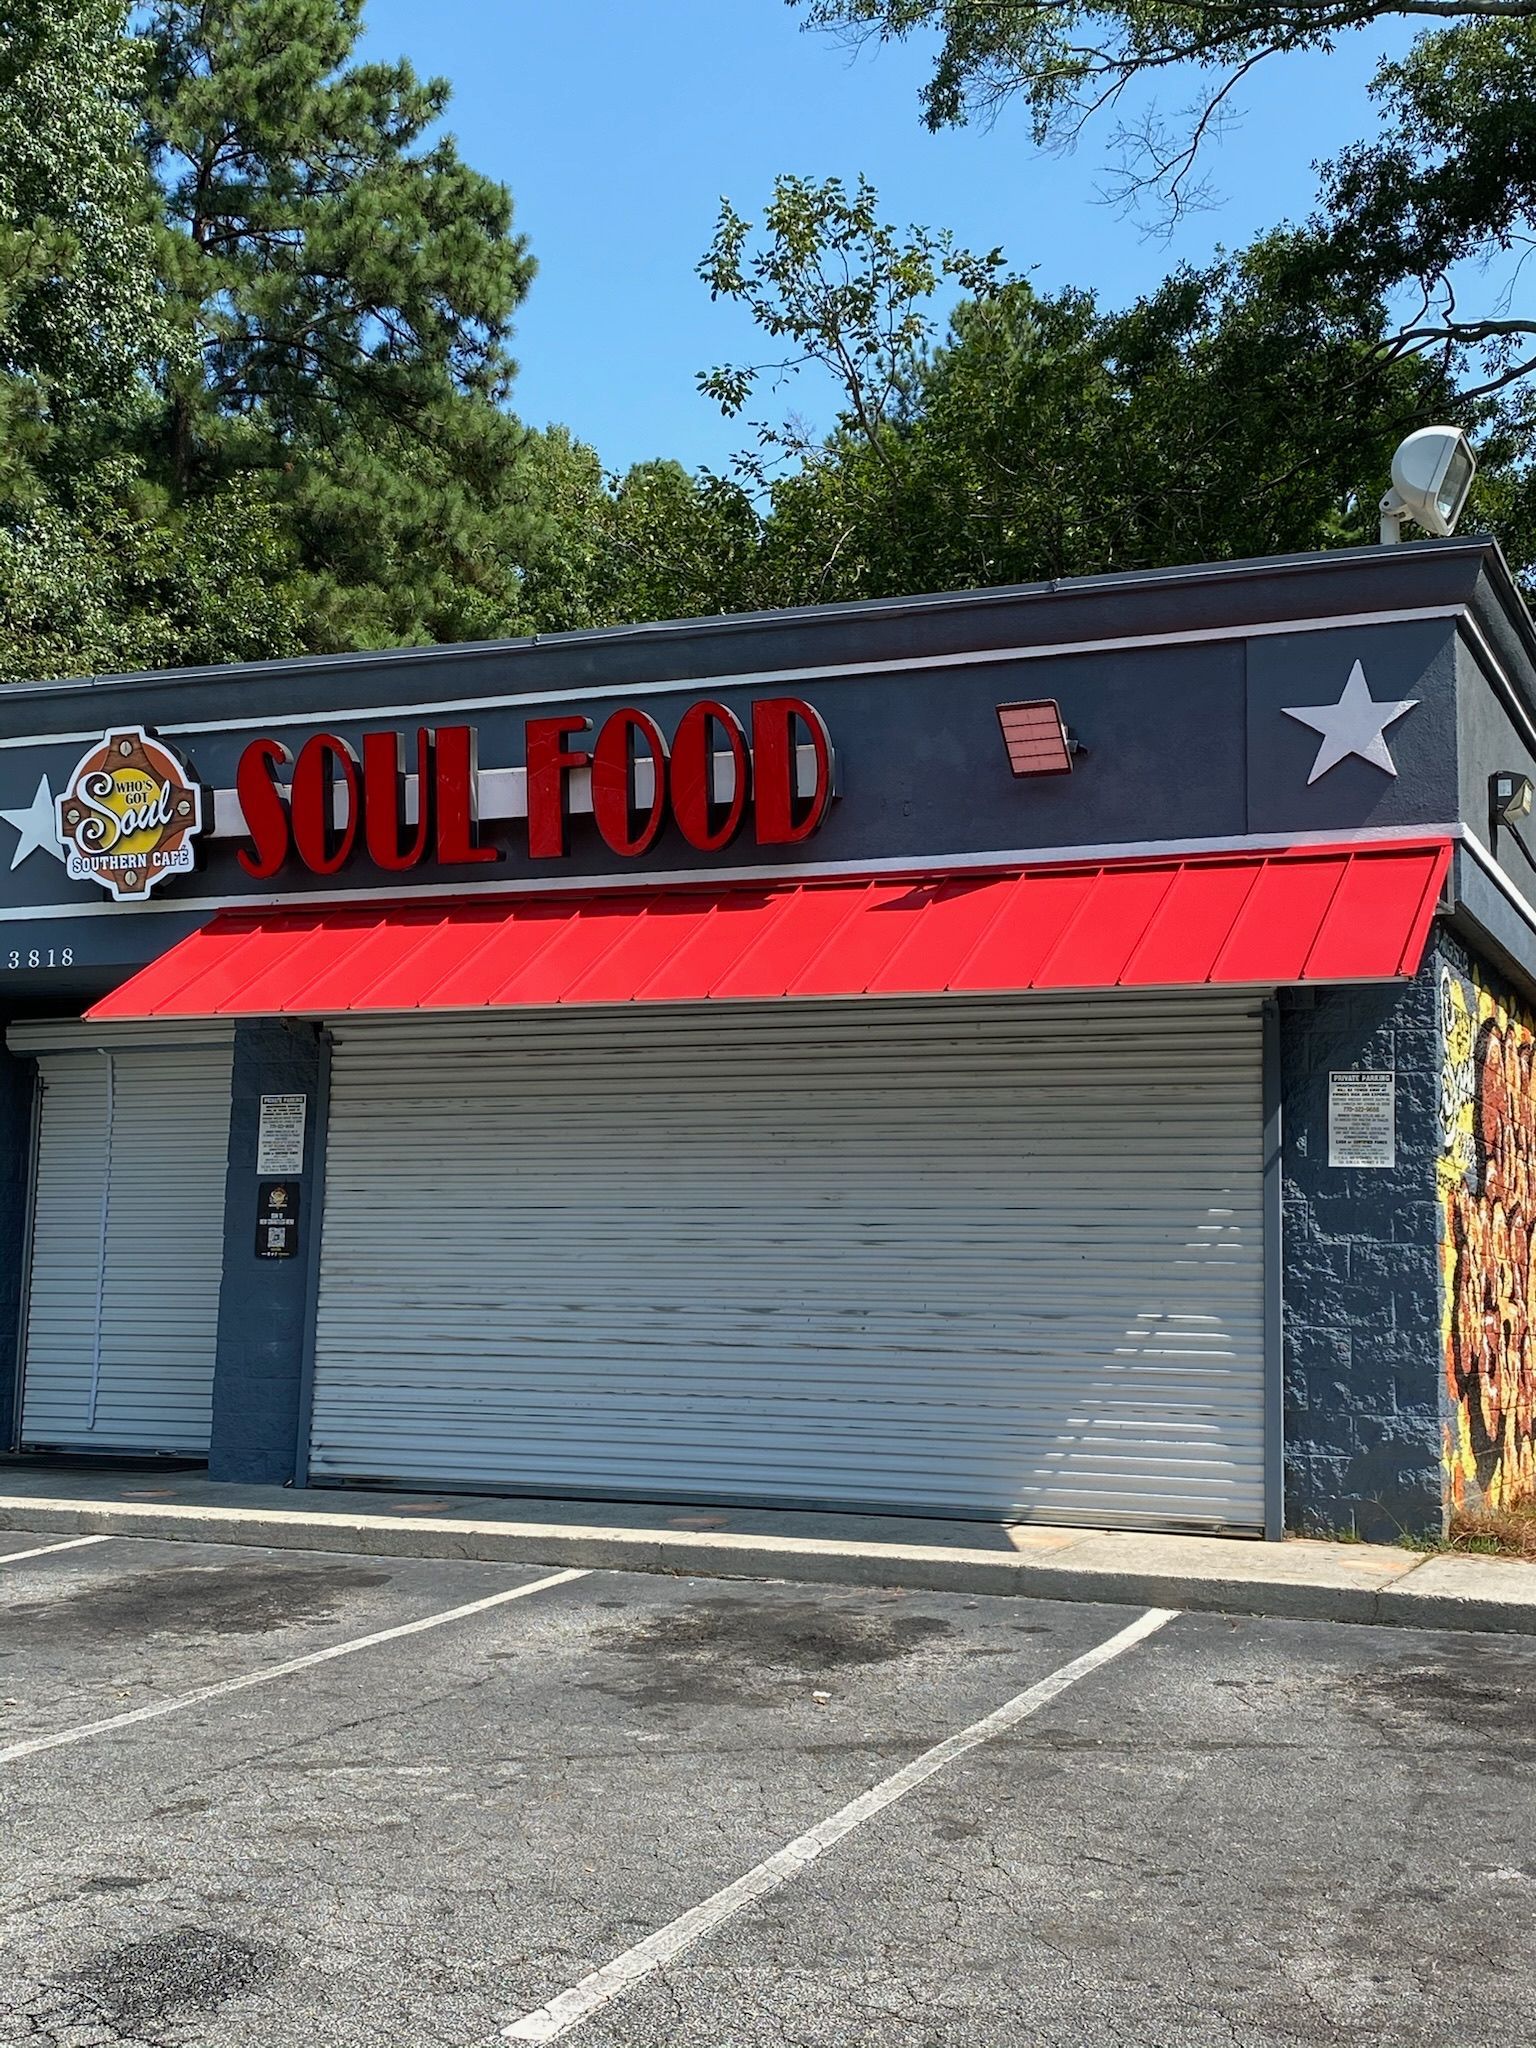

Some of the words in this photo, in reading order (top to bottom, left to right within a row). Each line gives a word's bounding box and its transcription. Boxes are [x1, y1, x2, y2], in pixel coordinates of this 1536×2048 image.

[116, 779, 153, 794] WHO'S
[236, 725, 500, 880] SOUL
[524, 697, 834, 859] FOOD
[125, 793, 149, 805] GOT
[75, 771, 174, 854] Soul
[73, 853, 147, 873] SOUTHERN
[152, 844, 189, 867] CAFÉ
[8, 947, 74, 970] 3818
[1333, 1074, 1360, 1082] PRIVATE
[1361, 1074, 1391, 1082] PARKING
